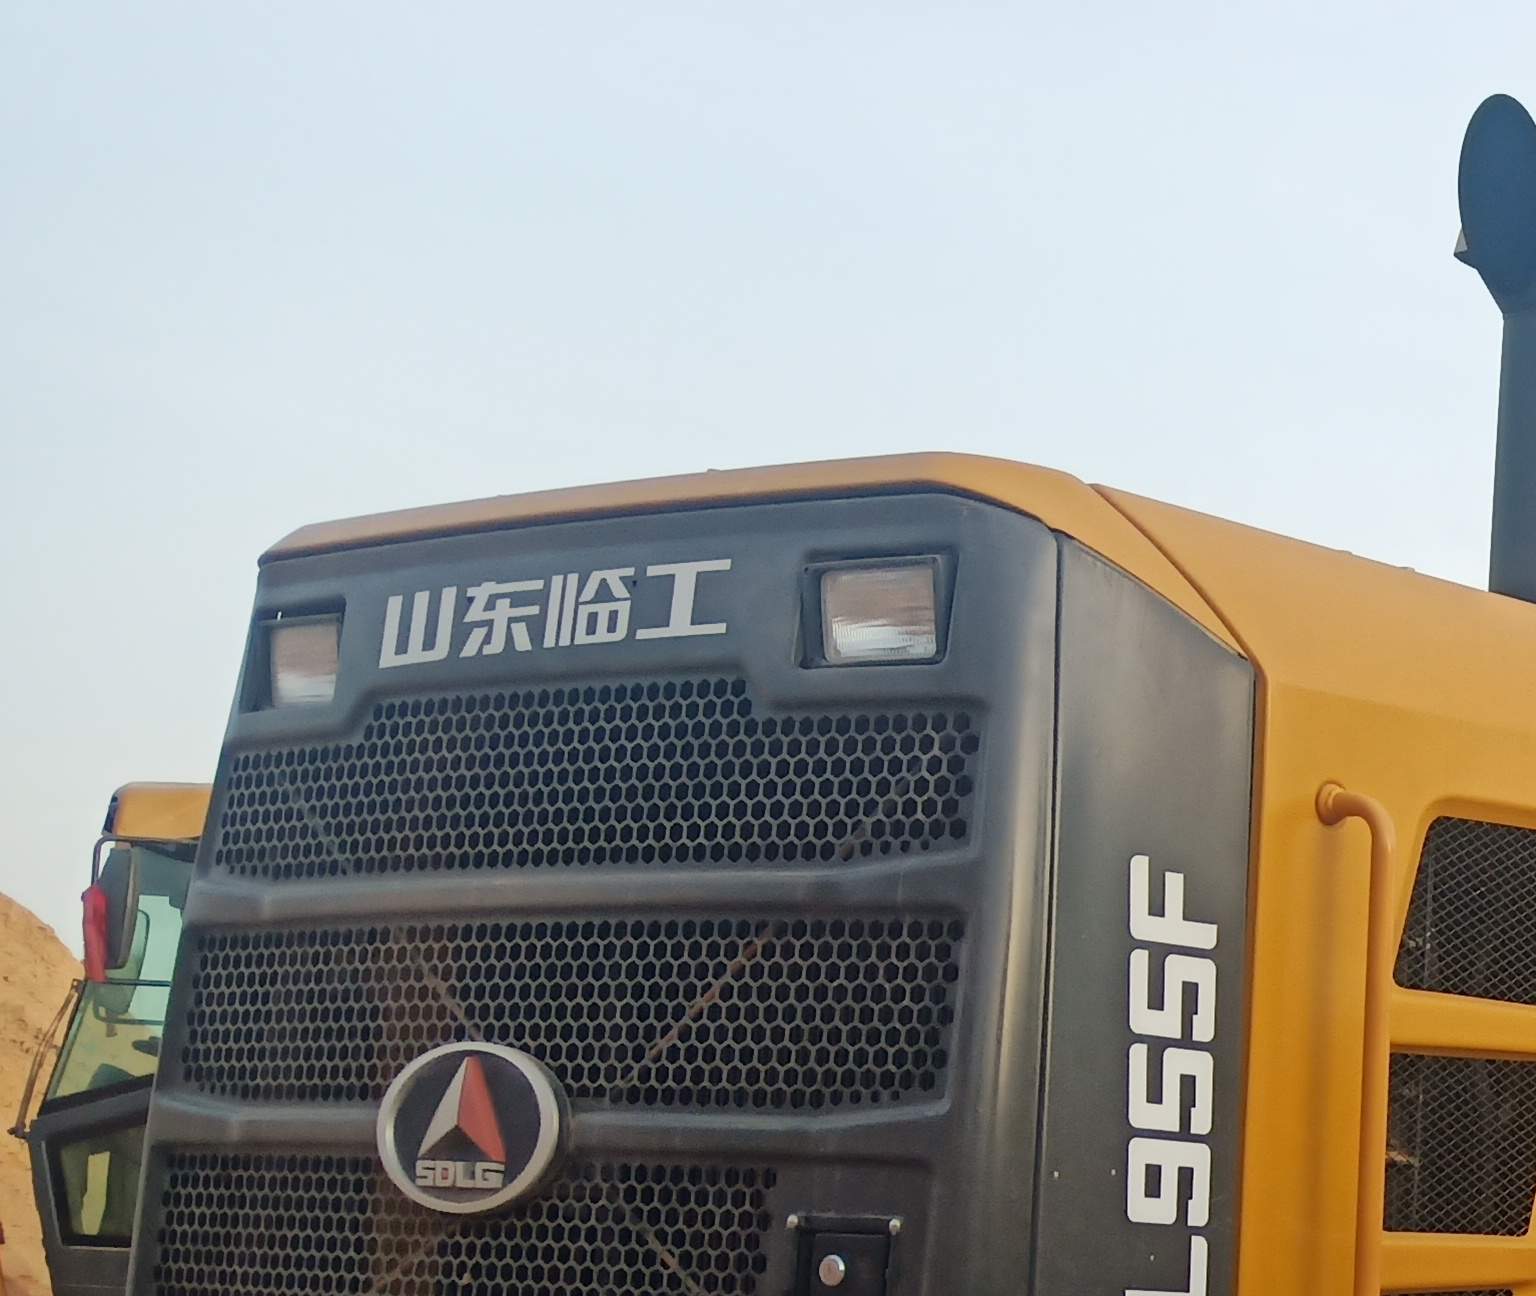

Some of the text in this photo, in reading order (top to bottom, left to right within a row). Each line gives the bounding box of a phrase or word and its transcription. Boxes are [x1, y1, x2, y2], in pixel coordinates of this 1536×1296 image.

[379, 559, 732, 669] 山东临工
[415, 1160, 505, 1189] SDLG
